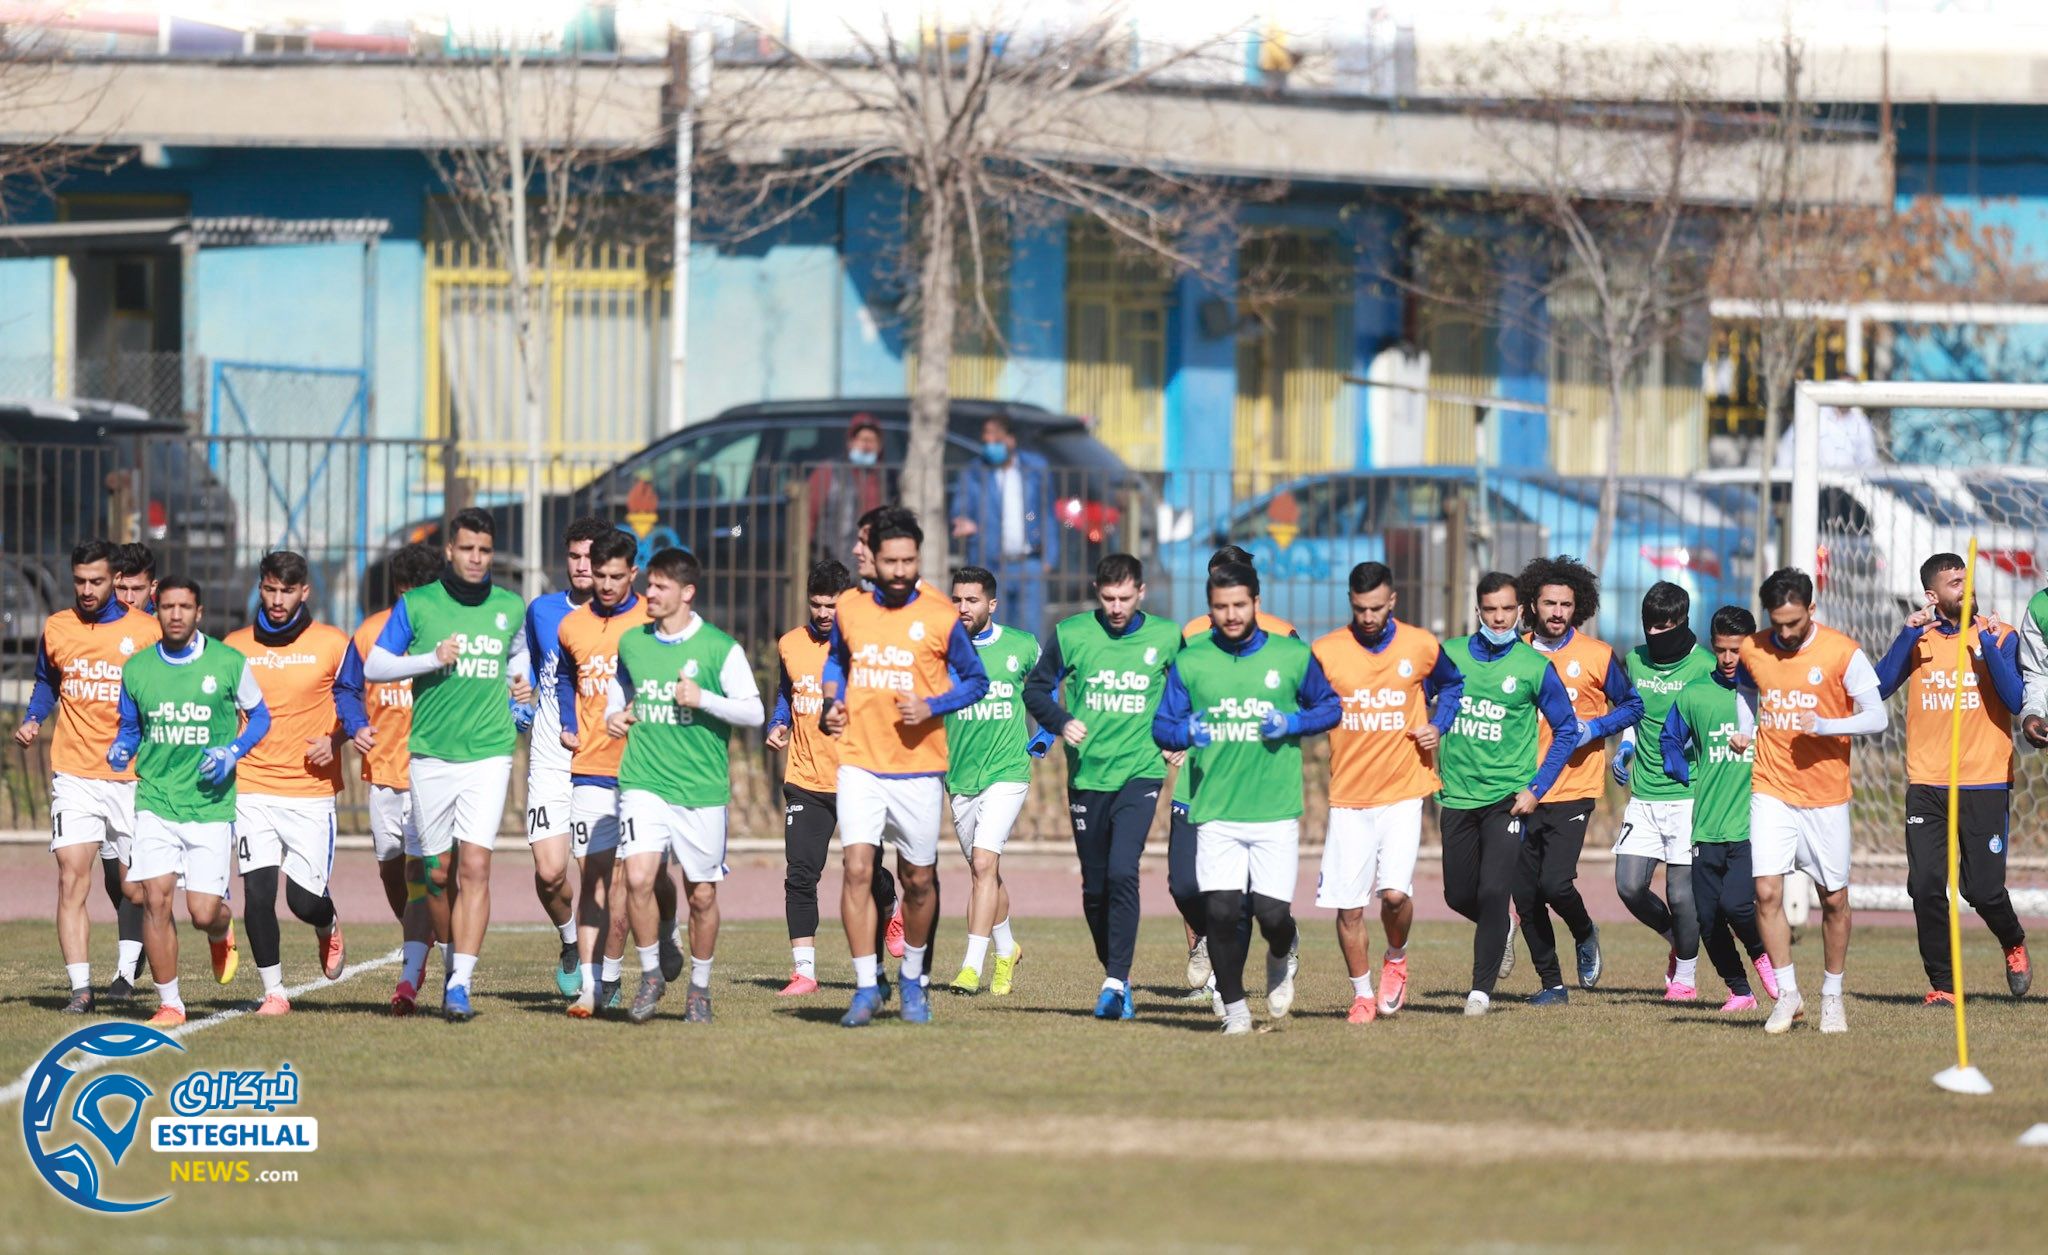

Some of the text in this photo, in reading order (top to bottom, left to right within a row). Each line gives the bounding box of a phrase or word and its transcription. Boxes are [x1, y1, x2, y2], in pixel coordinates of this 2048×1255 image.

[381, 688, 414, 707] HiW
[1086, 692, 1147, 714] HiWEB
[1208, 721, 1262, 742] HiWE
[1341, 711, 1406, 732] HiWEB
[1760, 711, 1803, 732] HiWE
[146, 725, 210, 746] HiWEB
[1708, 745, 1757, 764] HiWE
[1507, 820, 1521, 834] 40
